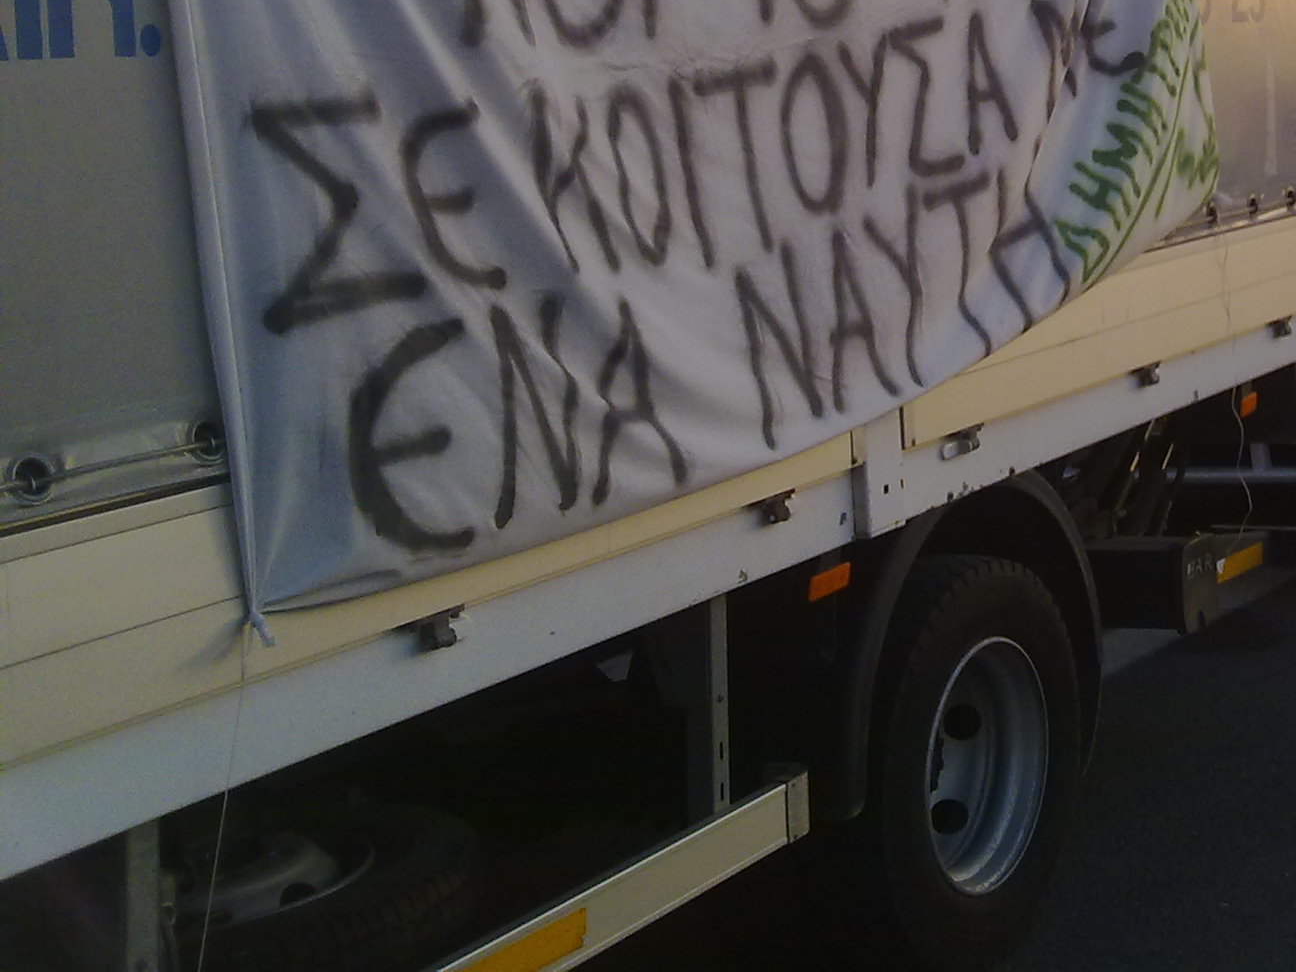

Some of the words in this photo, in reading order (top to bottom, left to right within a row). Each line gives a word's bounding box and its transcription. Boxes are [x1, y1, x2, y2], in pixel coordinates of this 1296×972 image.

[249, 92, 507, 334] ΣΕ
[530, 10, 1019, 273] ΚΟΙΤΟΥΣΑ
[348, 290, 689, 554] ΕΝΑ
